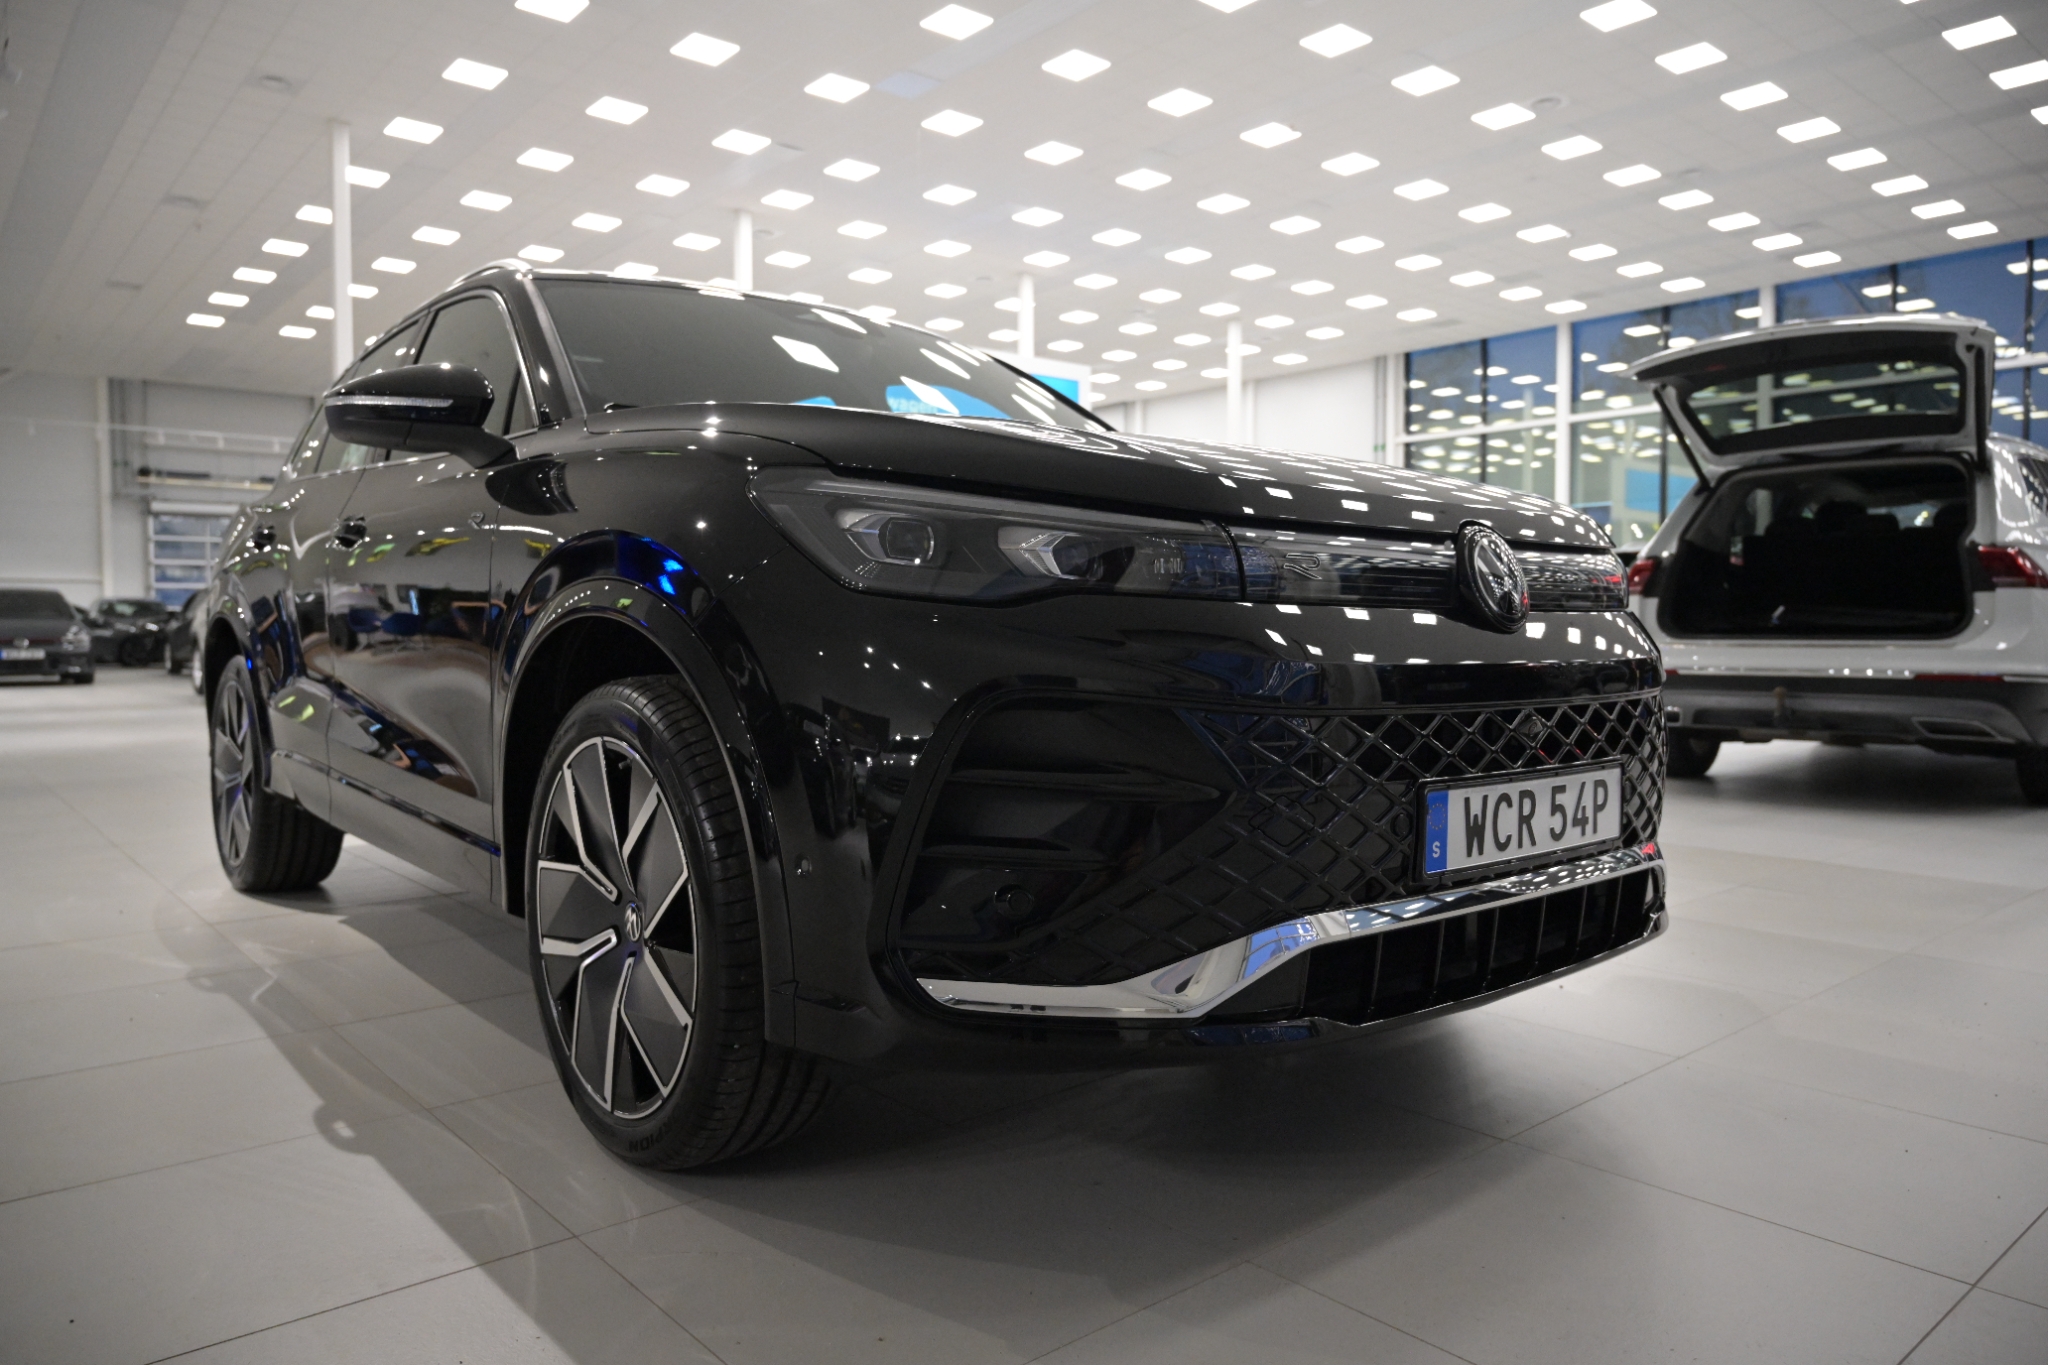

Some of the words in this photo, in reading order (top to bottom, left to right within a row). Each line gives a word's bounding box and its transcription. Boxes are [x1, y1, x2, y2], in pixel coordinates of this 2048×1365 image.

[1464, 788, 1537, 858] WCR
[1549, 778, 1610, 842] 54P
[1432, 841, 1441, 858] S
